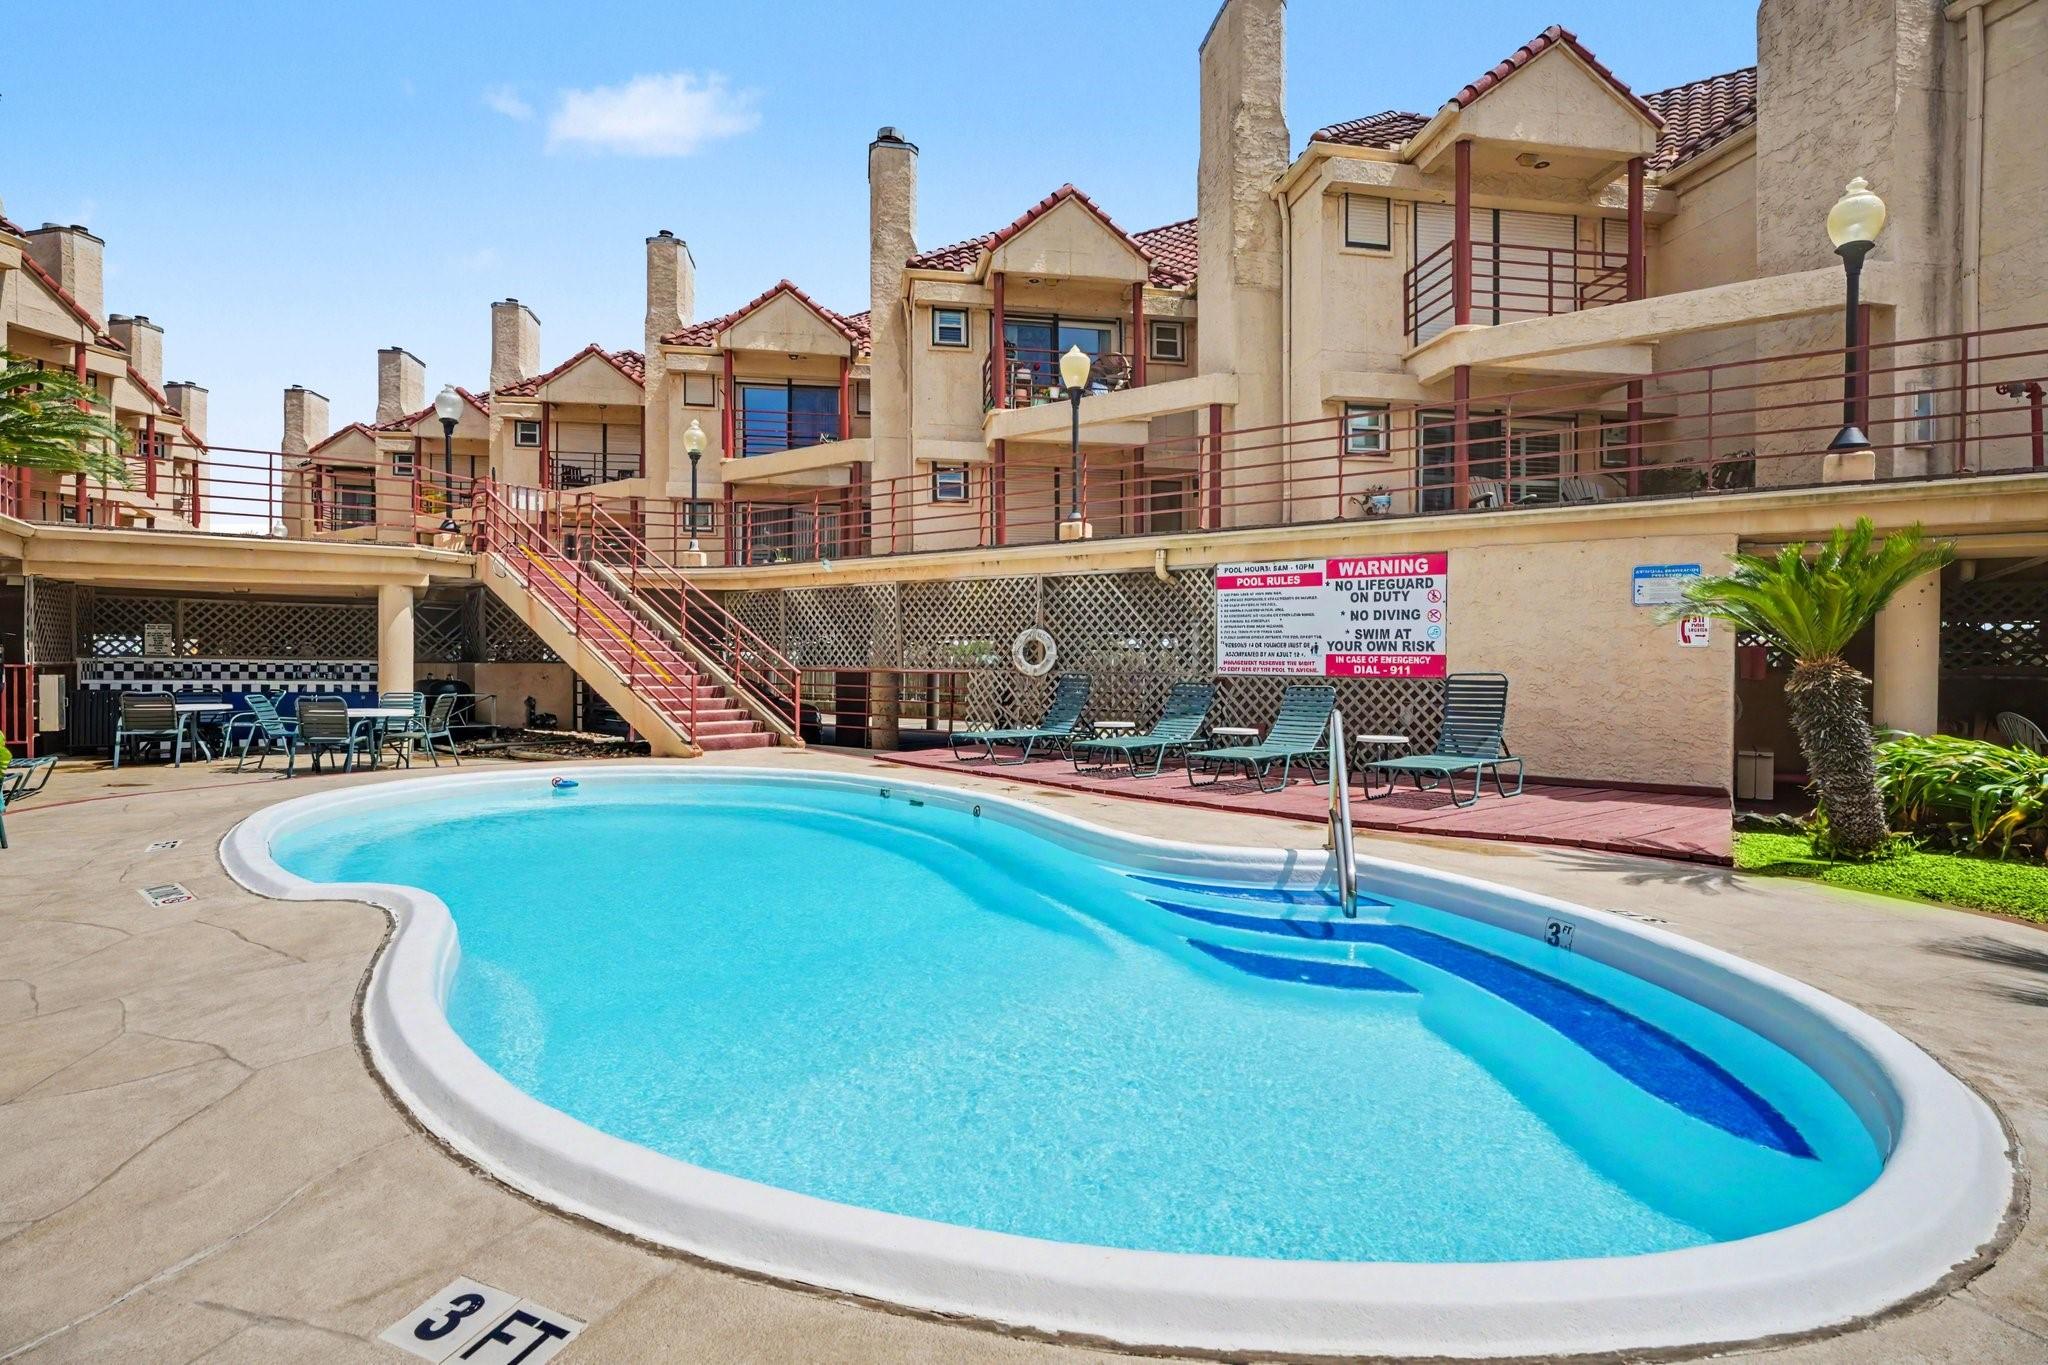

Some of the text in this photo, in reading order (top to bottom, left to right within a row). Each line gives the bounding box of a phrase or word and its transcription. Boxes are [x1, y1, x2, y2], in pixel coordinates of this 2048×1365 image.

[1244, 565, 1271, 573] HOURS:
[1338, 558, 1429, 576] WARNING
[1236, 576, 1300, 586] POOL RULES
[1335, 577, 1434, 591] NO LIFEGUARD
[1350, 590, 1410, 603] ON DUTY
[1350, 609, 1420, 621] NO DIVING
[1354, 628, 1412, 640] SWIM AT
[1327, 641, 1435, 652] YOUR OWN RISK
[1380, 656, 1431, 664] EMERGENCY
[1354, 666, 1380, 674] DIAL
[1390, 666, 1410, 674] 911
[1548, 922, 1572, 947] 3 FT
[414, 1293, 571, 1365] 3 FT
